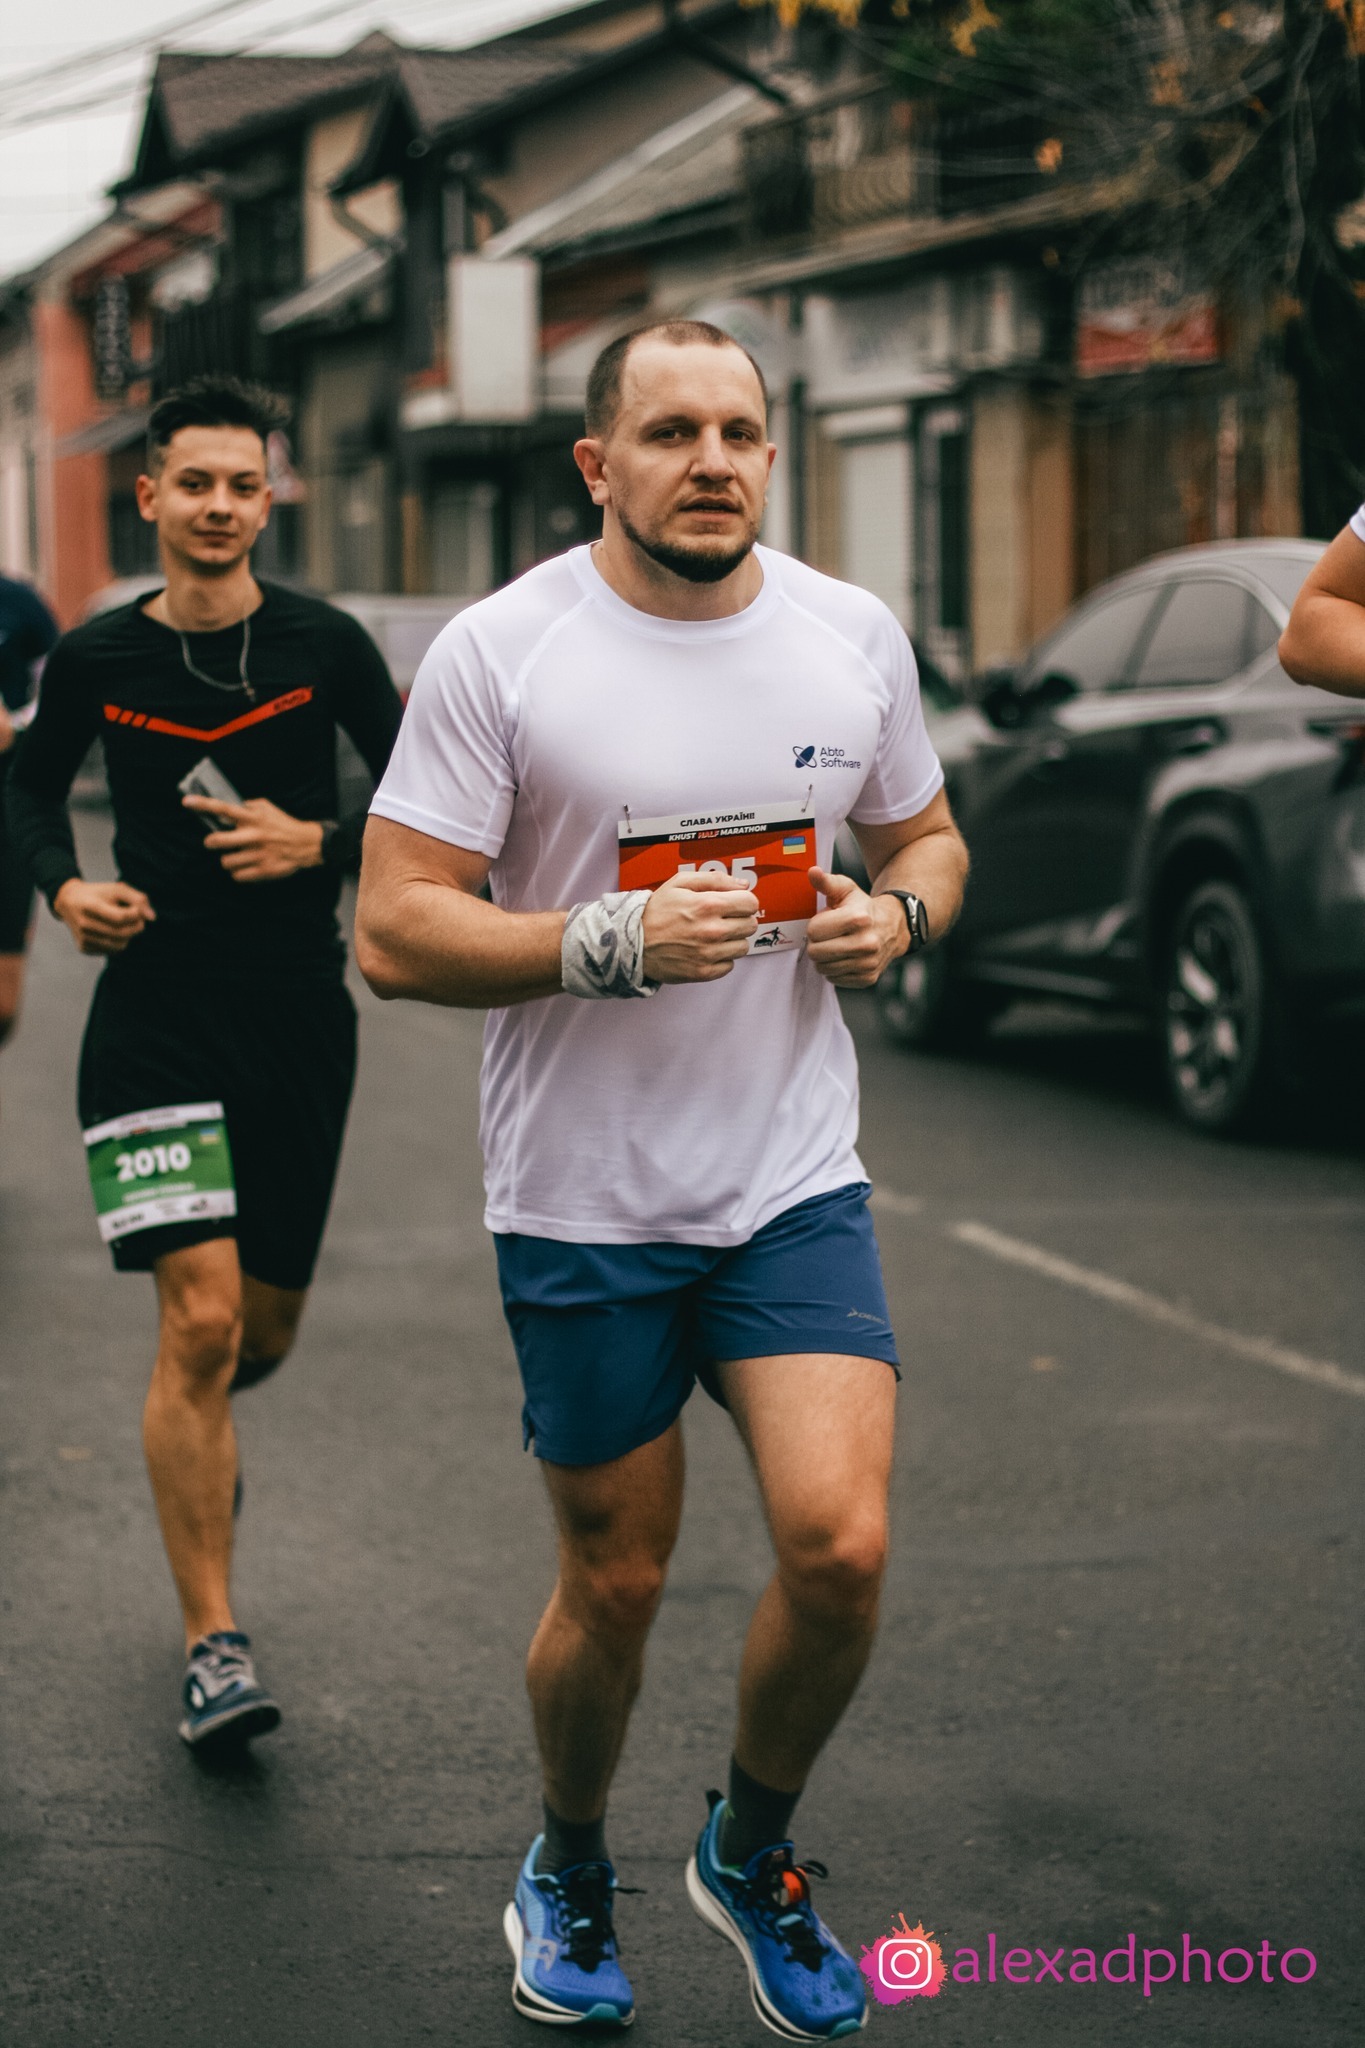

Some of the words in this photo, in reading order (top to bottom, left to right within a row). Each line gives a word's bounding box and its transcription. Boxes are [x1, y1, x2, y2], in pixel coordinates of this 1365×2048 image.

[820, 746, 845, 757] Abto
[820, 757, 862, 769] Software
[680, 817, 713, 827] СЛАВА
[668, 832, 697, 842] KHUST
[697, 830, 720, 839] HALF
[719, 824, 767, 836] MARATHON
[114, 1142, 192, 1183] 2010
